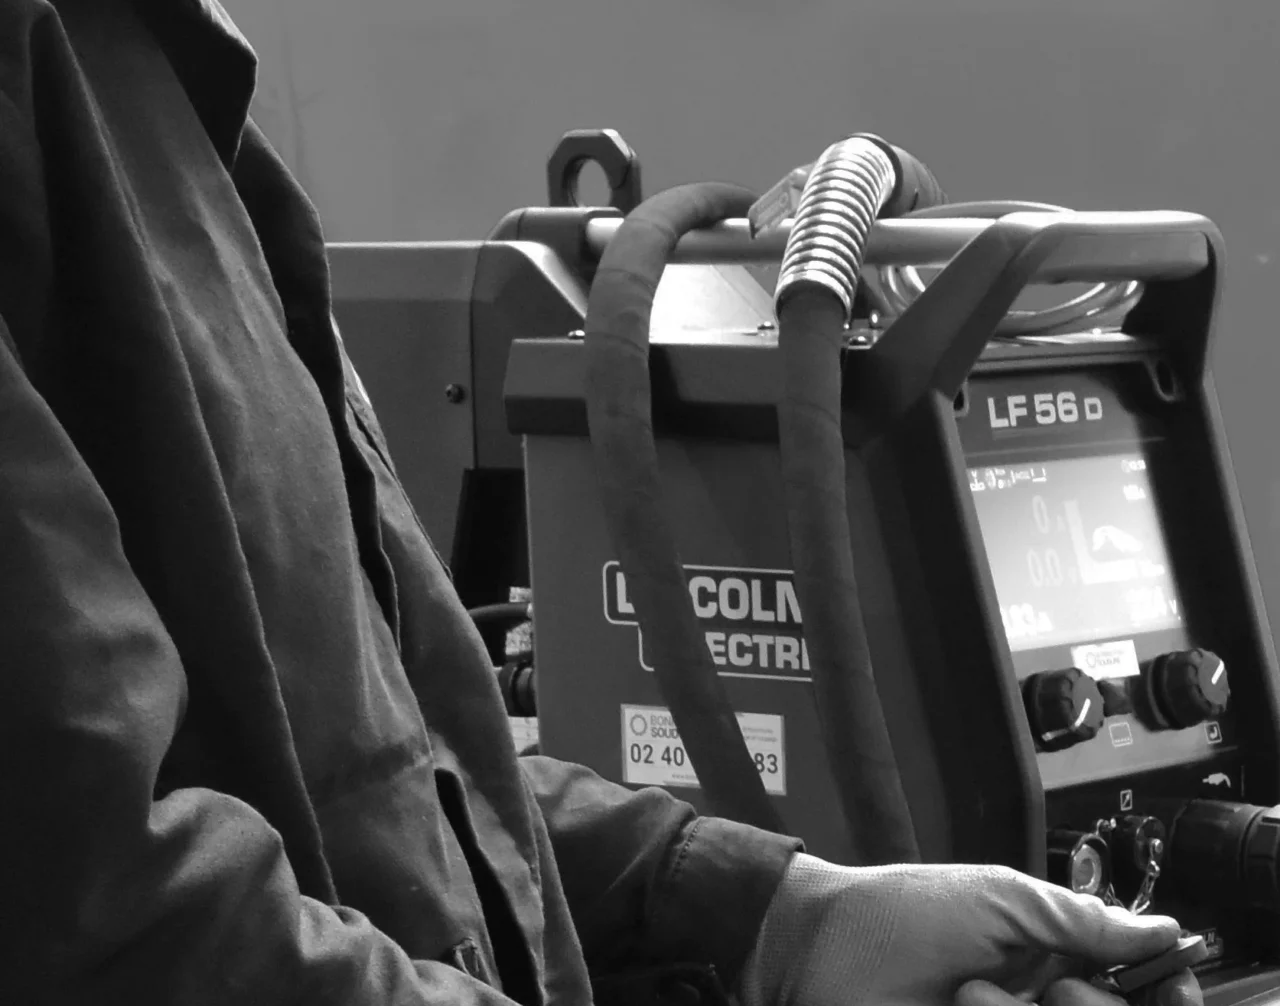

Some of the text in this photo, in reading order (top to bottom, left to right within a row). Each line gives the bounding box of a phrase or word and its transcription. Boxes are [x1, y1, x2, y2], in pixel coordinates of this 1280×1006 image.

[987, 391, 1103, 428] LF 56 D
[616, 572, 802, 623] LCOLN
[705, 631, 811, 671] ECTRI
[630, 743, 778, 774] 02 40 83
